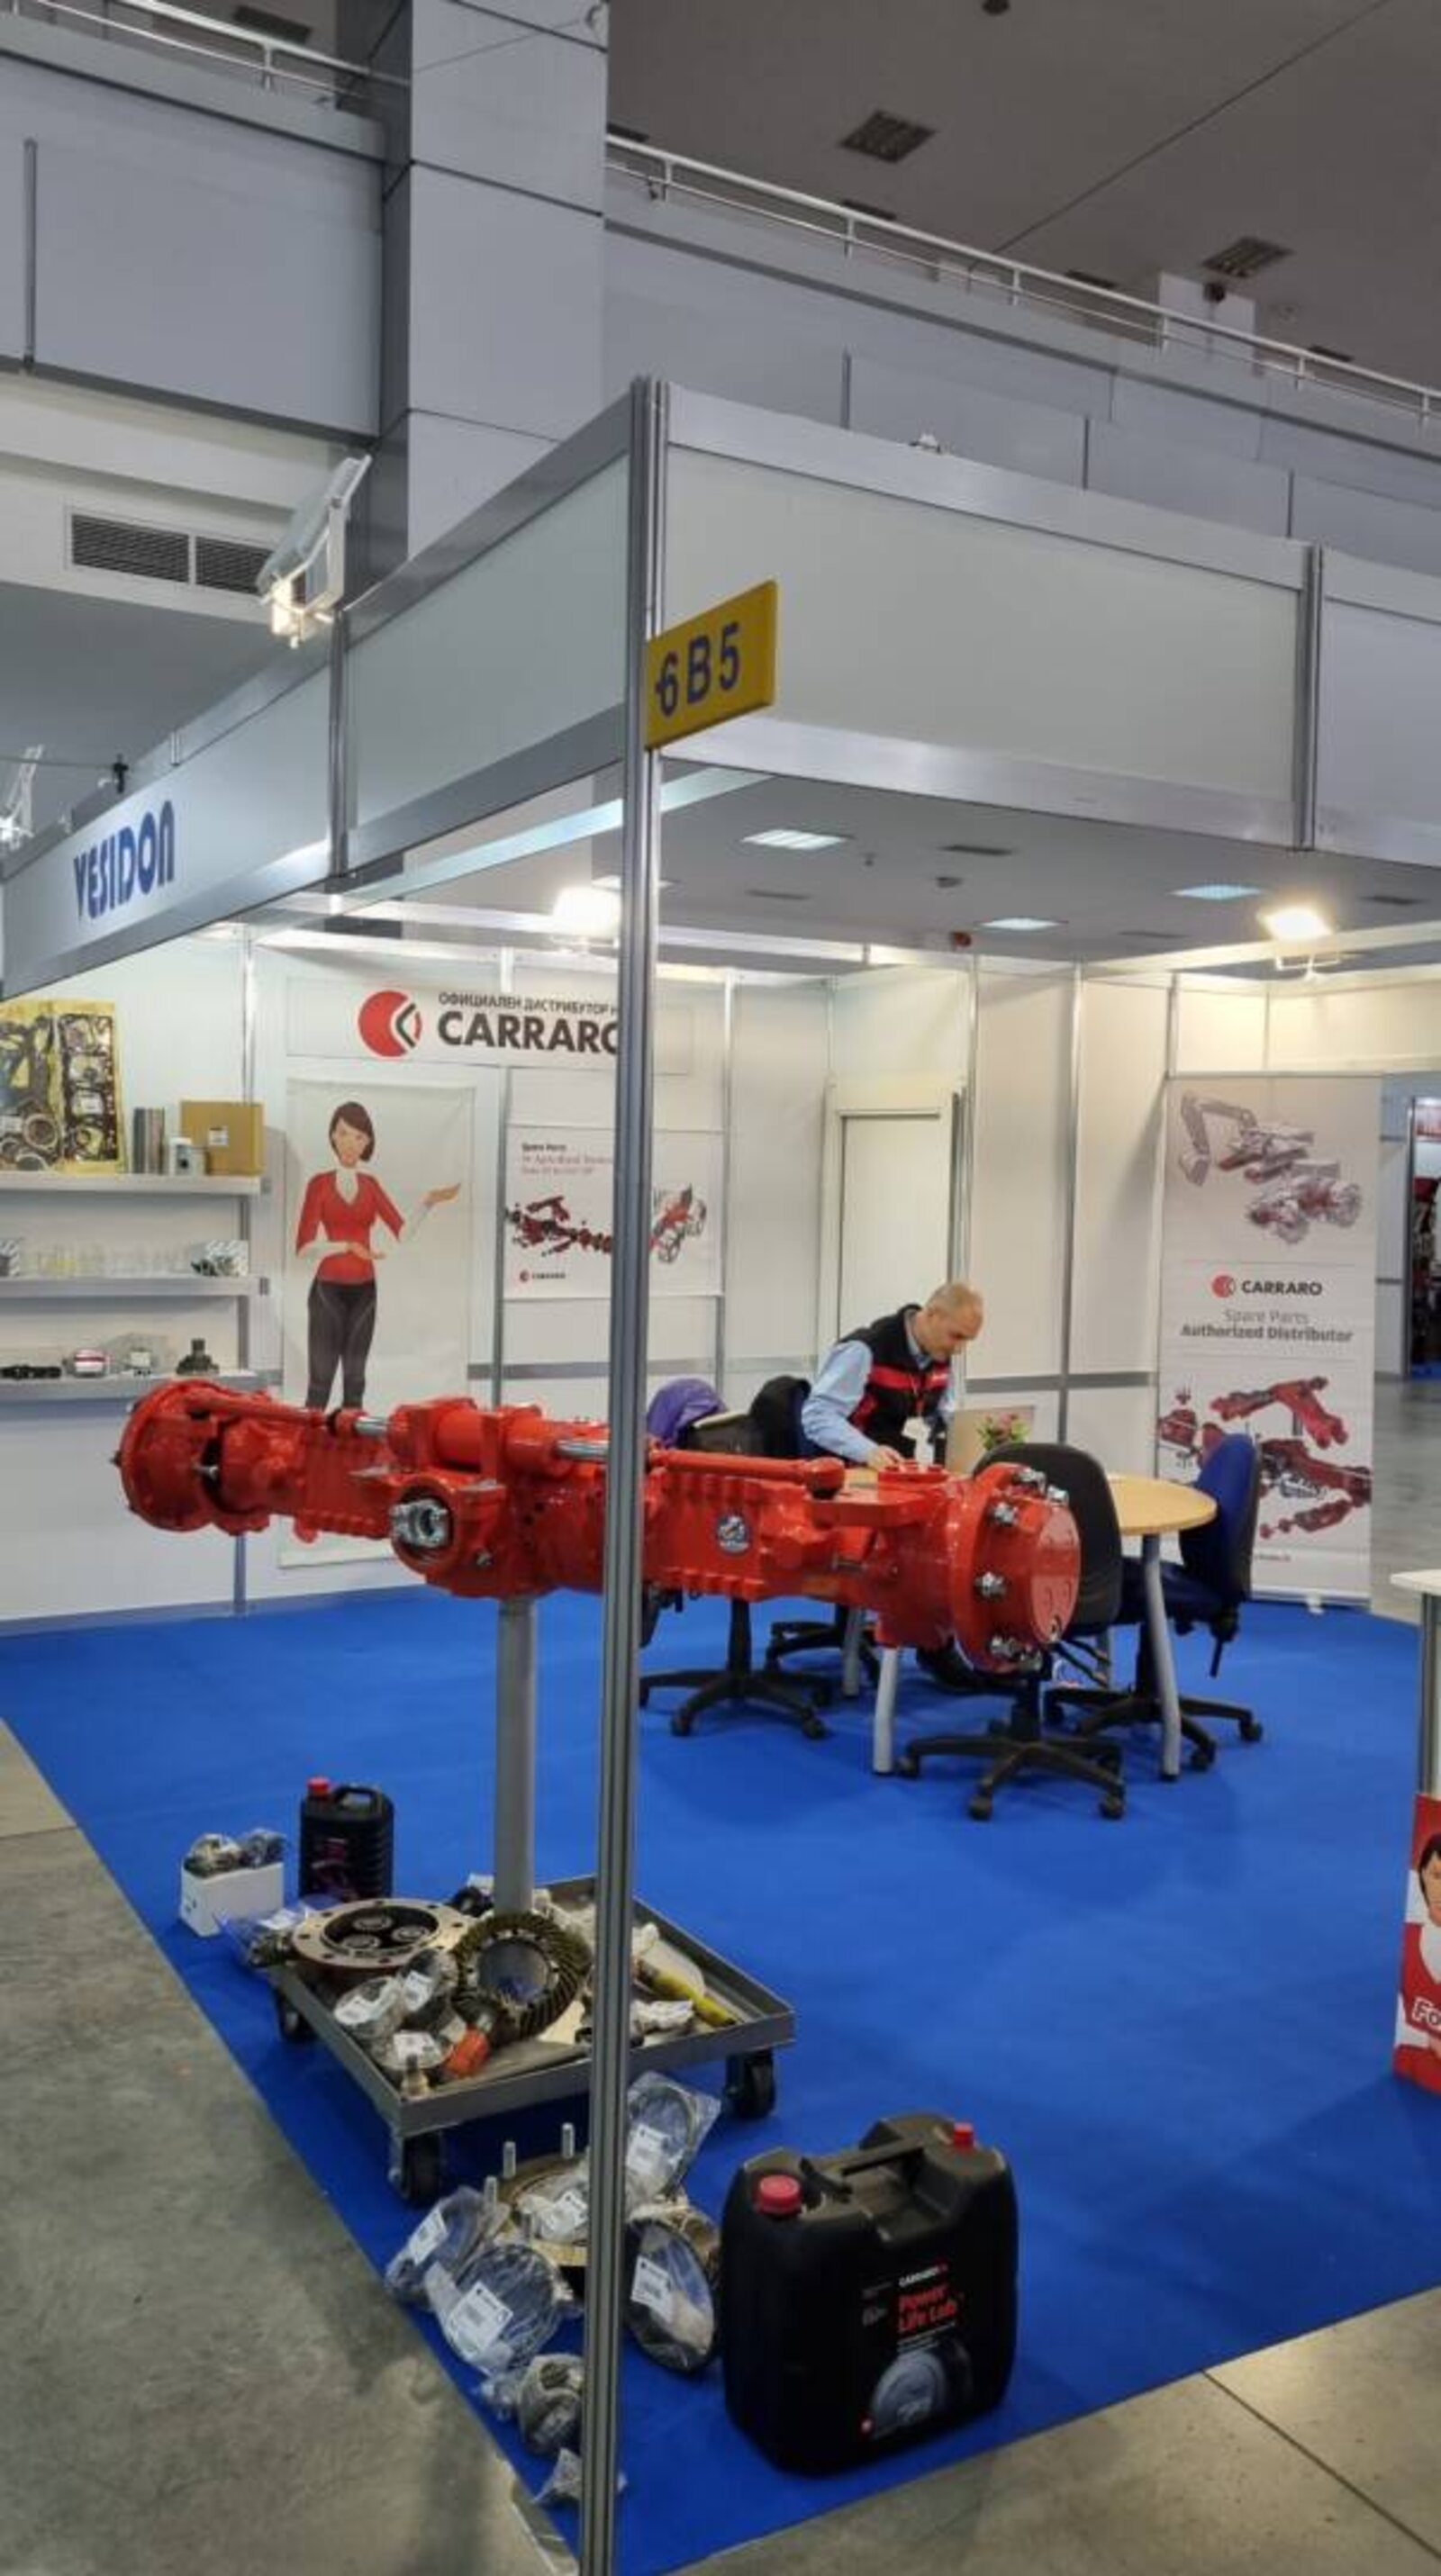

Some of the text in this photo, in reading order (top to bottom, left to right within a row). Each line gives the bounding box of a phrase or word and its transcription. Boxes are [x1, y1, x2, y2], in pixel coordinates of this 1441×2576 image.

[438, 991, 521, 1010] ОФИЦИАЛЕН
[523, 998, 609, 1015] ДИСТРИБУТОР
[1241, 1279, 1323, 1297] CARRARO
[1224, 1308, 1310, 1324] Spare Parts
[1180, 1324, 1353, 1342] Authorized Distributor
